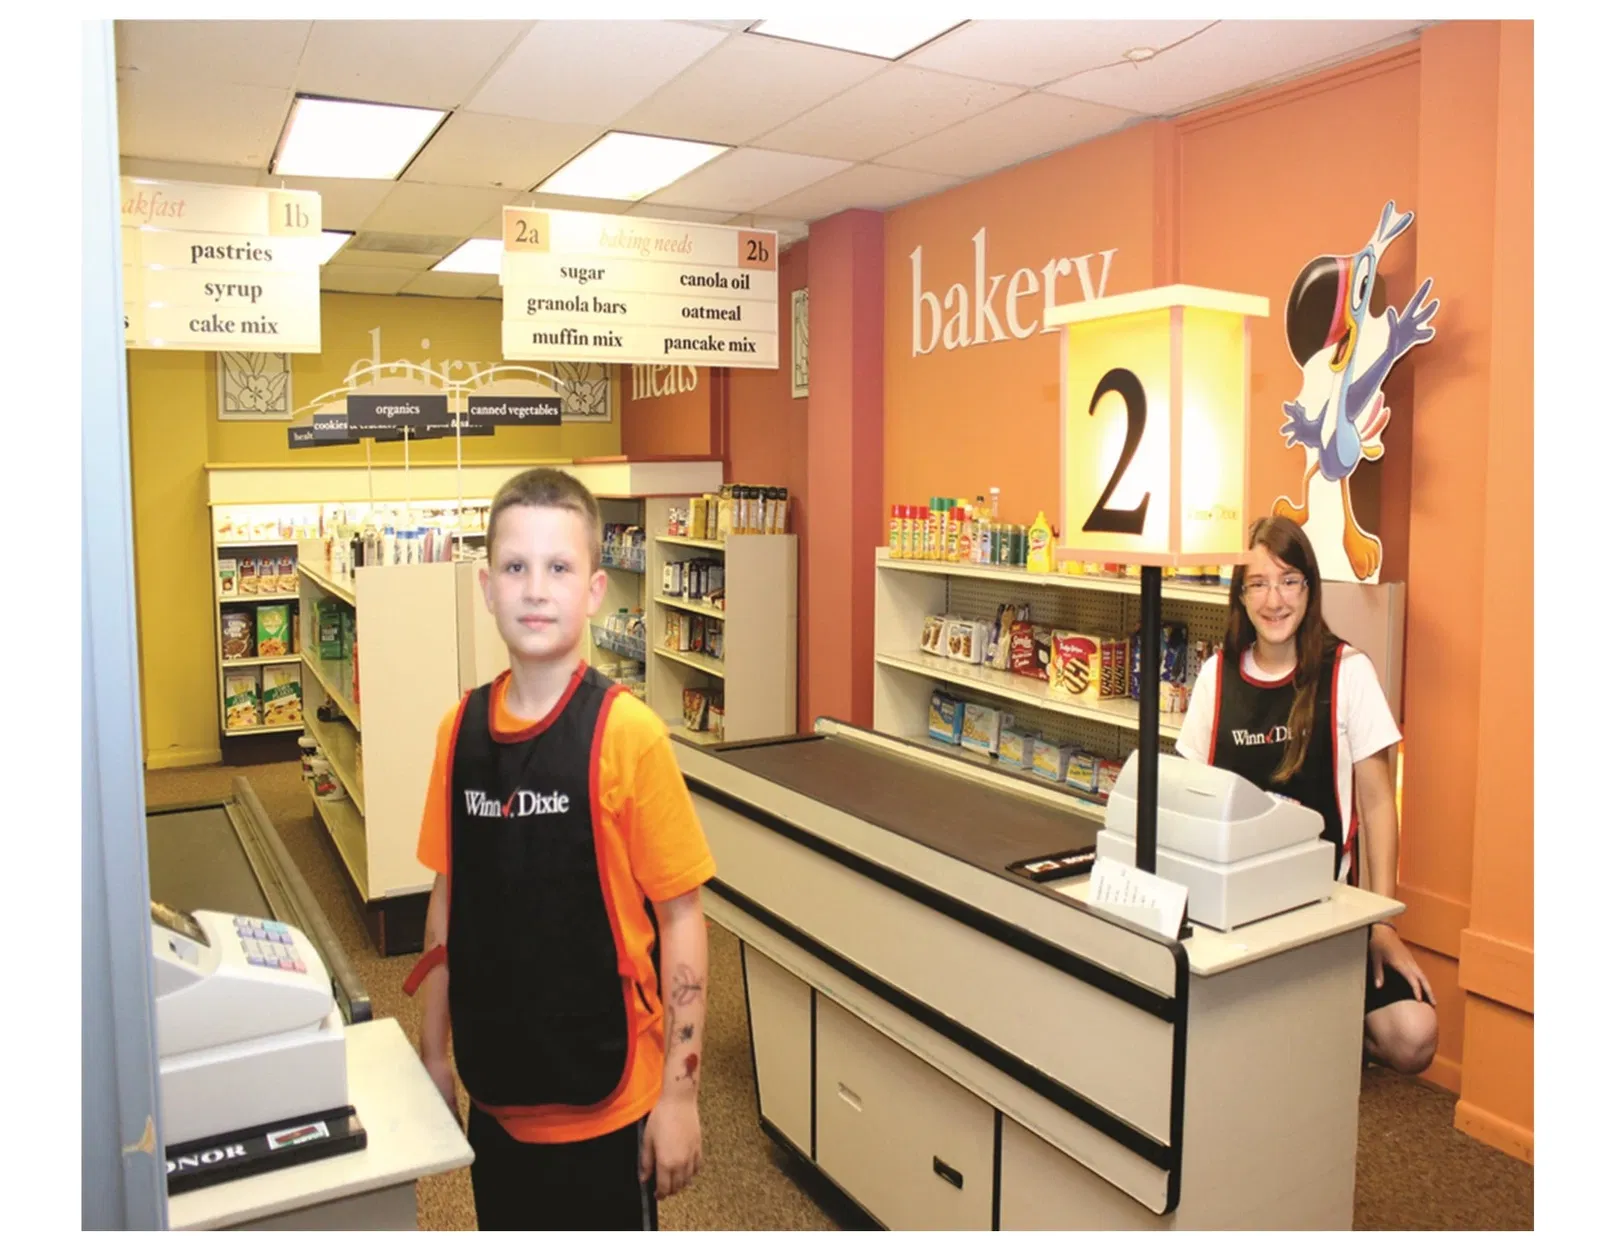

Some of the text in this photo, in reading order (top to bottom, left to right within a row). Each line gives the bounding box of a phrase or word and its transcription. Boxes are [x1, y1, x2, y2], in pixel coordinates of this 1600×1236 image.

[283, 202, 310, 229] 1b
[514, 219, 540, 245] 2a
[600, 227, 693, 256] baking needs
[190, 241, 273, 264] pastries
[746, 239, 770, 262] 2b
[559, 265, 605, 285] sugar
[679, 272, 751, 290] canola oil
[204, 279, 263, 304] syrup
[526, 296, 628, 316] granola bars
[681, 305, 742, 322] oatmeal
[189, 314, 279, 335] cake mix
[532, 328, 624, 348] muffin mix
[663, 335, 757, 355] pancake mix
[375, 402, 421, 418] organics
[470, 403, 560, 419] canned vegetables
[313, 420, 348, 431] cookies
[1081, 367, 1151, 535] 2
[1231, 728, 1266, 746] Winn
[464, 789, 570, 818] Winn Dixie
